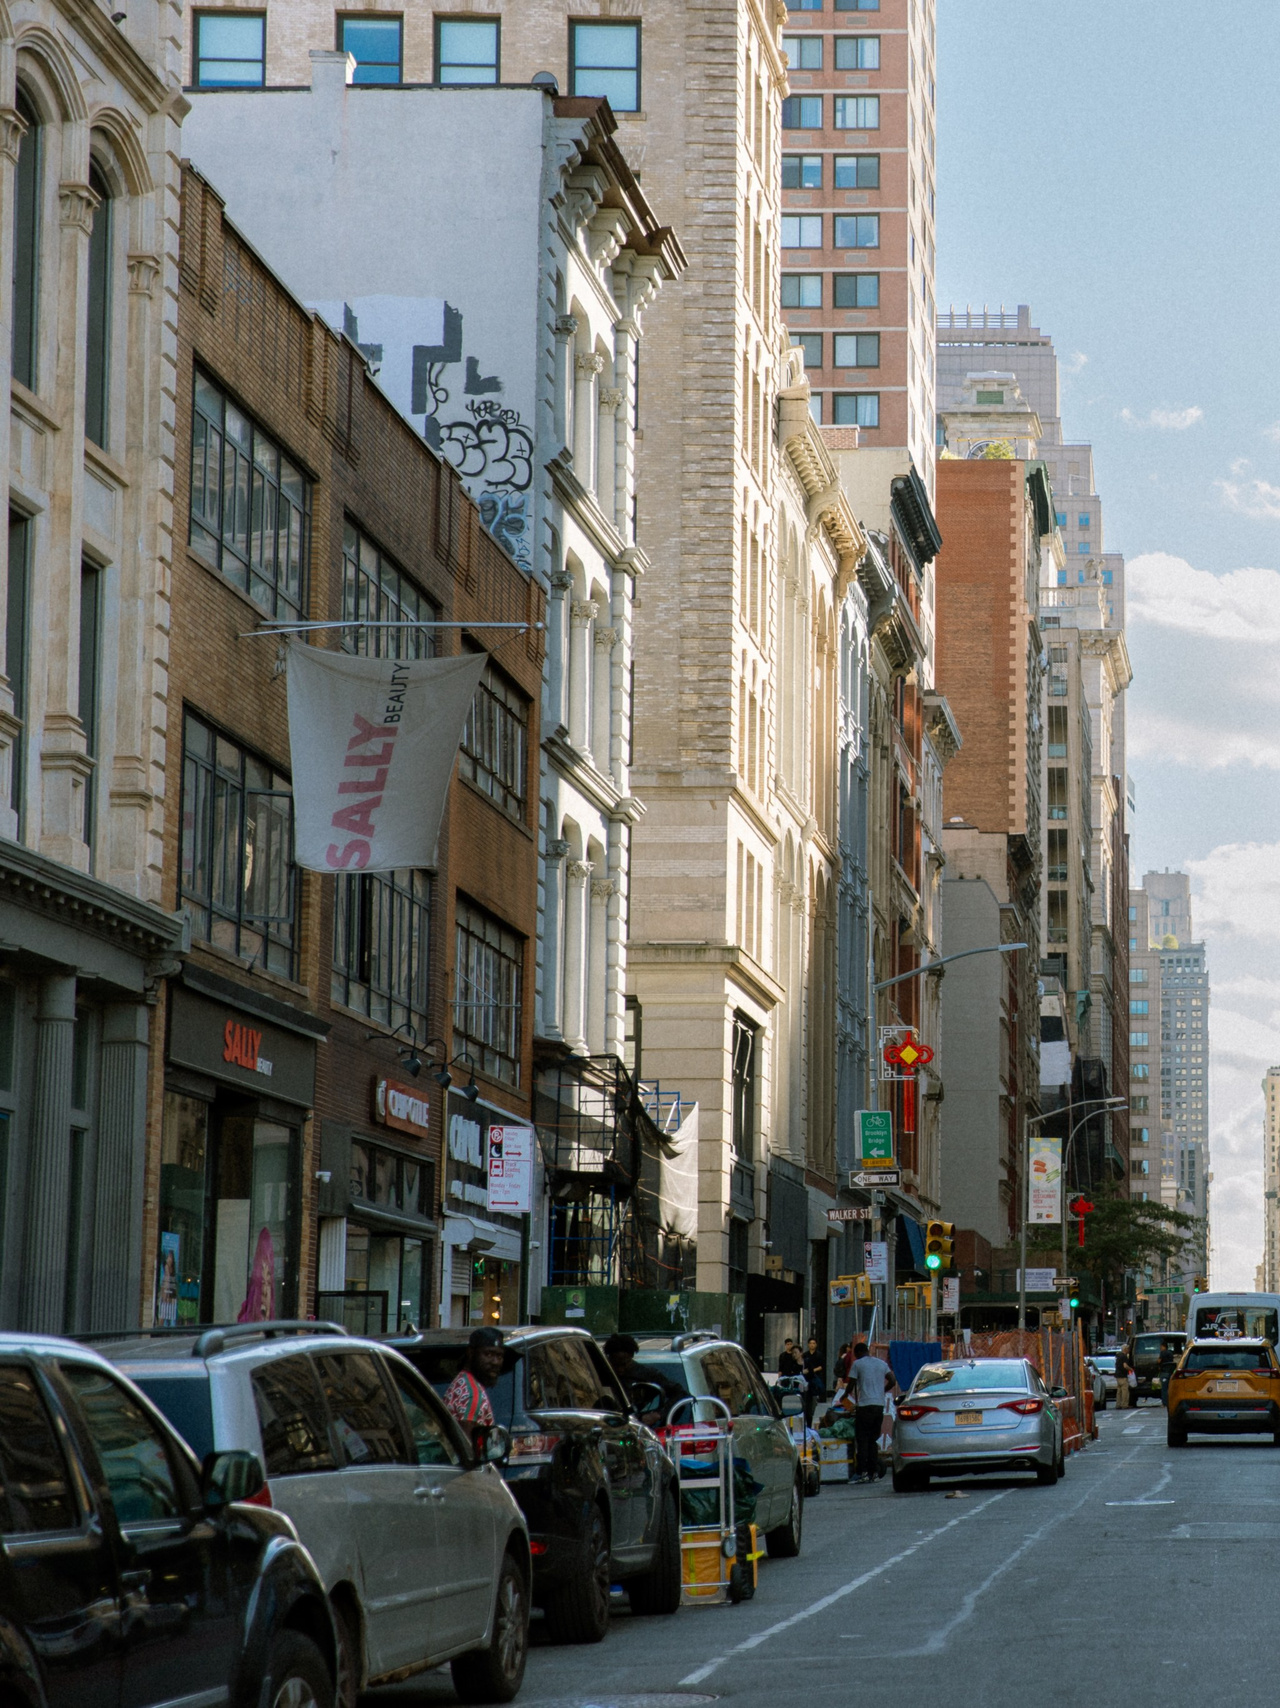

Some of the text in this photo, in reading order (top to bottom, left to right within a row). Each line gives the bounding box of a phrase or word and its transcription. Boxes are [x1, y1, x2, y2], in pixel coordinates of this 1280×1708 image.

[383, 662, 410, 724] BEAUTY
[326, 712, 399, 869] SALLY
[223, 1019, 263, 1071] SALLY
[857, 1175, 872, 1183] ONE
[828, 1208, 869, 1220] WALKER ST
